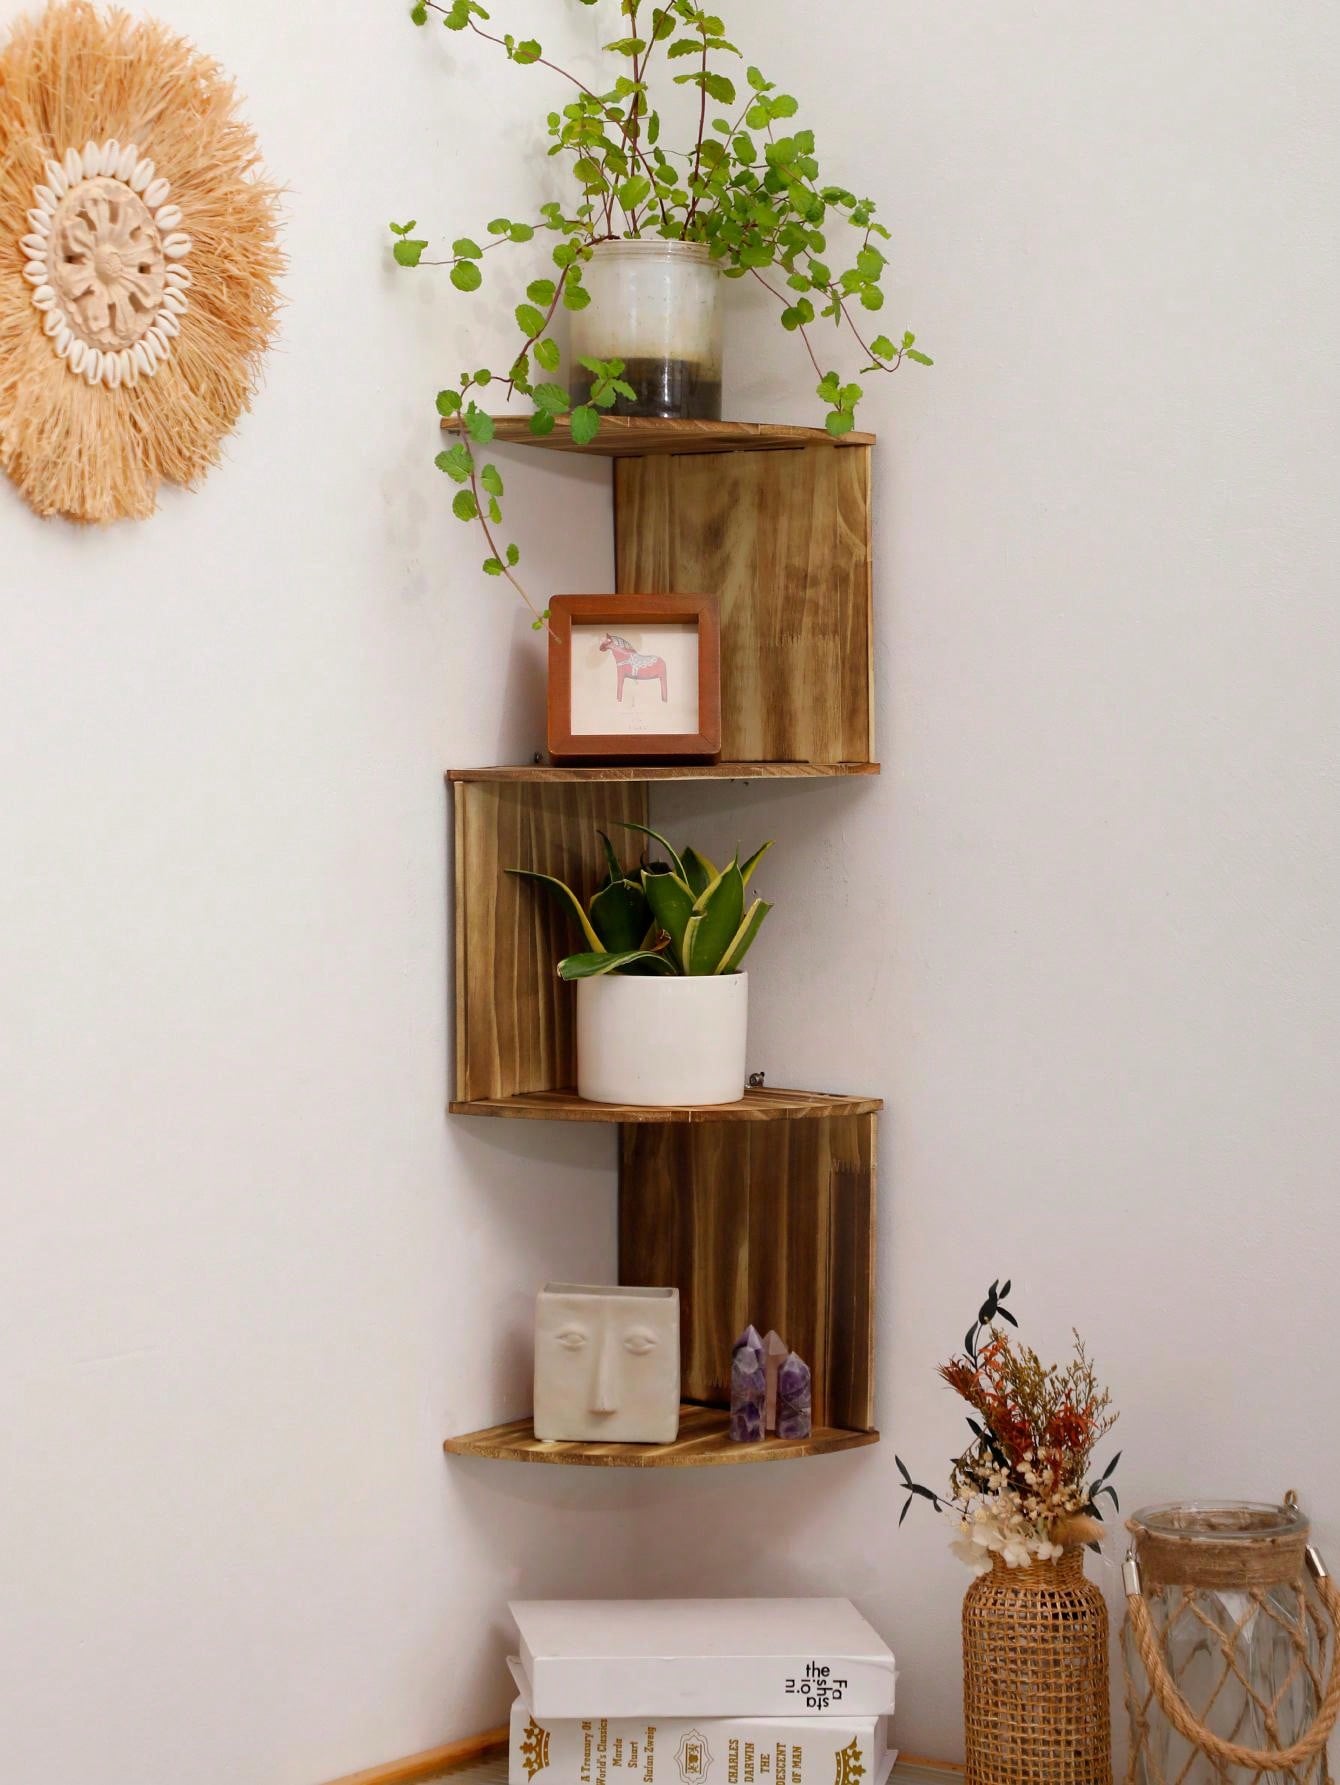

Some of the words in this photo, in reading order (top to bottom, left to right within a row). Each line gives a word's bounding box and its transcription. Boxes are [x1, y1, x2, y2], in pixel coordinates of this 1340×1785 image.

[806, 1660, 831, 1678] the
[580, 1732, 594, 1773] Treasury
[728, 1738, 739, 1784] CHARLES
[744, 1742, 755, 1783] DARWIN
[760, 1753, 770, 1774] THE
[776, 1742, 787, 1785] DESCENT
[792, 1745, 802, 1769] MAN
[792, 1771, 802, 1784] OF
